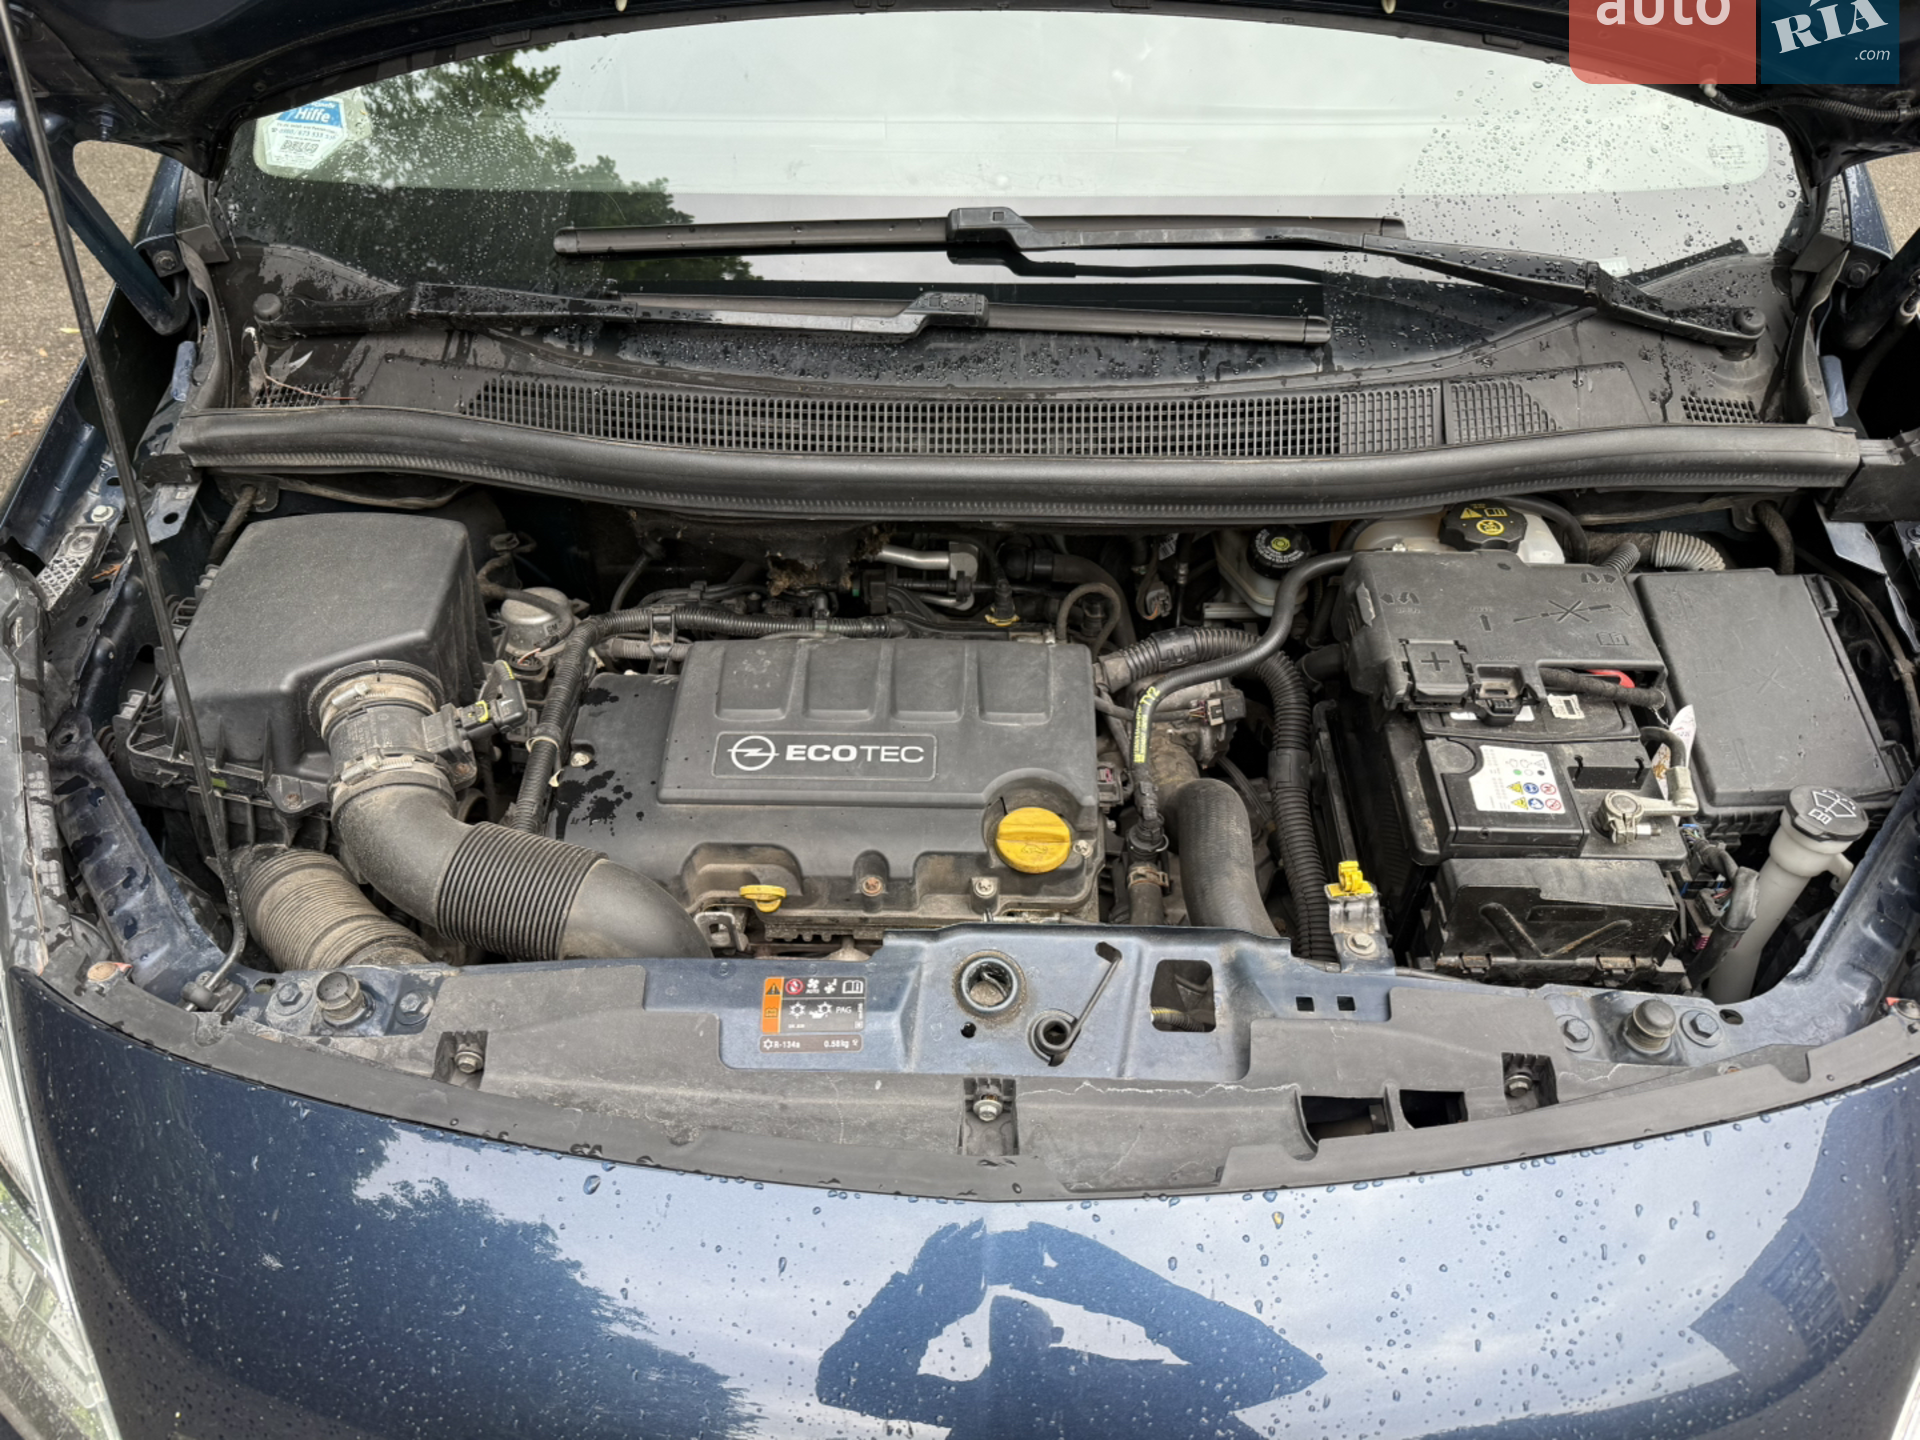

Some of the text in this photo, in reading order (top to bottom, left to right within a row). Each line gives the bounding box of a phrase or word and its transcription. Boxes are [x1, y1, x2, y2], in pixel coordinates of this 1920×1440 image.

[294, 107, 331, 123] Hilfe
[785, 744, 925, 763] ECOTEC
[835, 1006, 852, 1014] PAG
